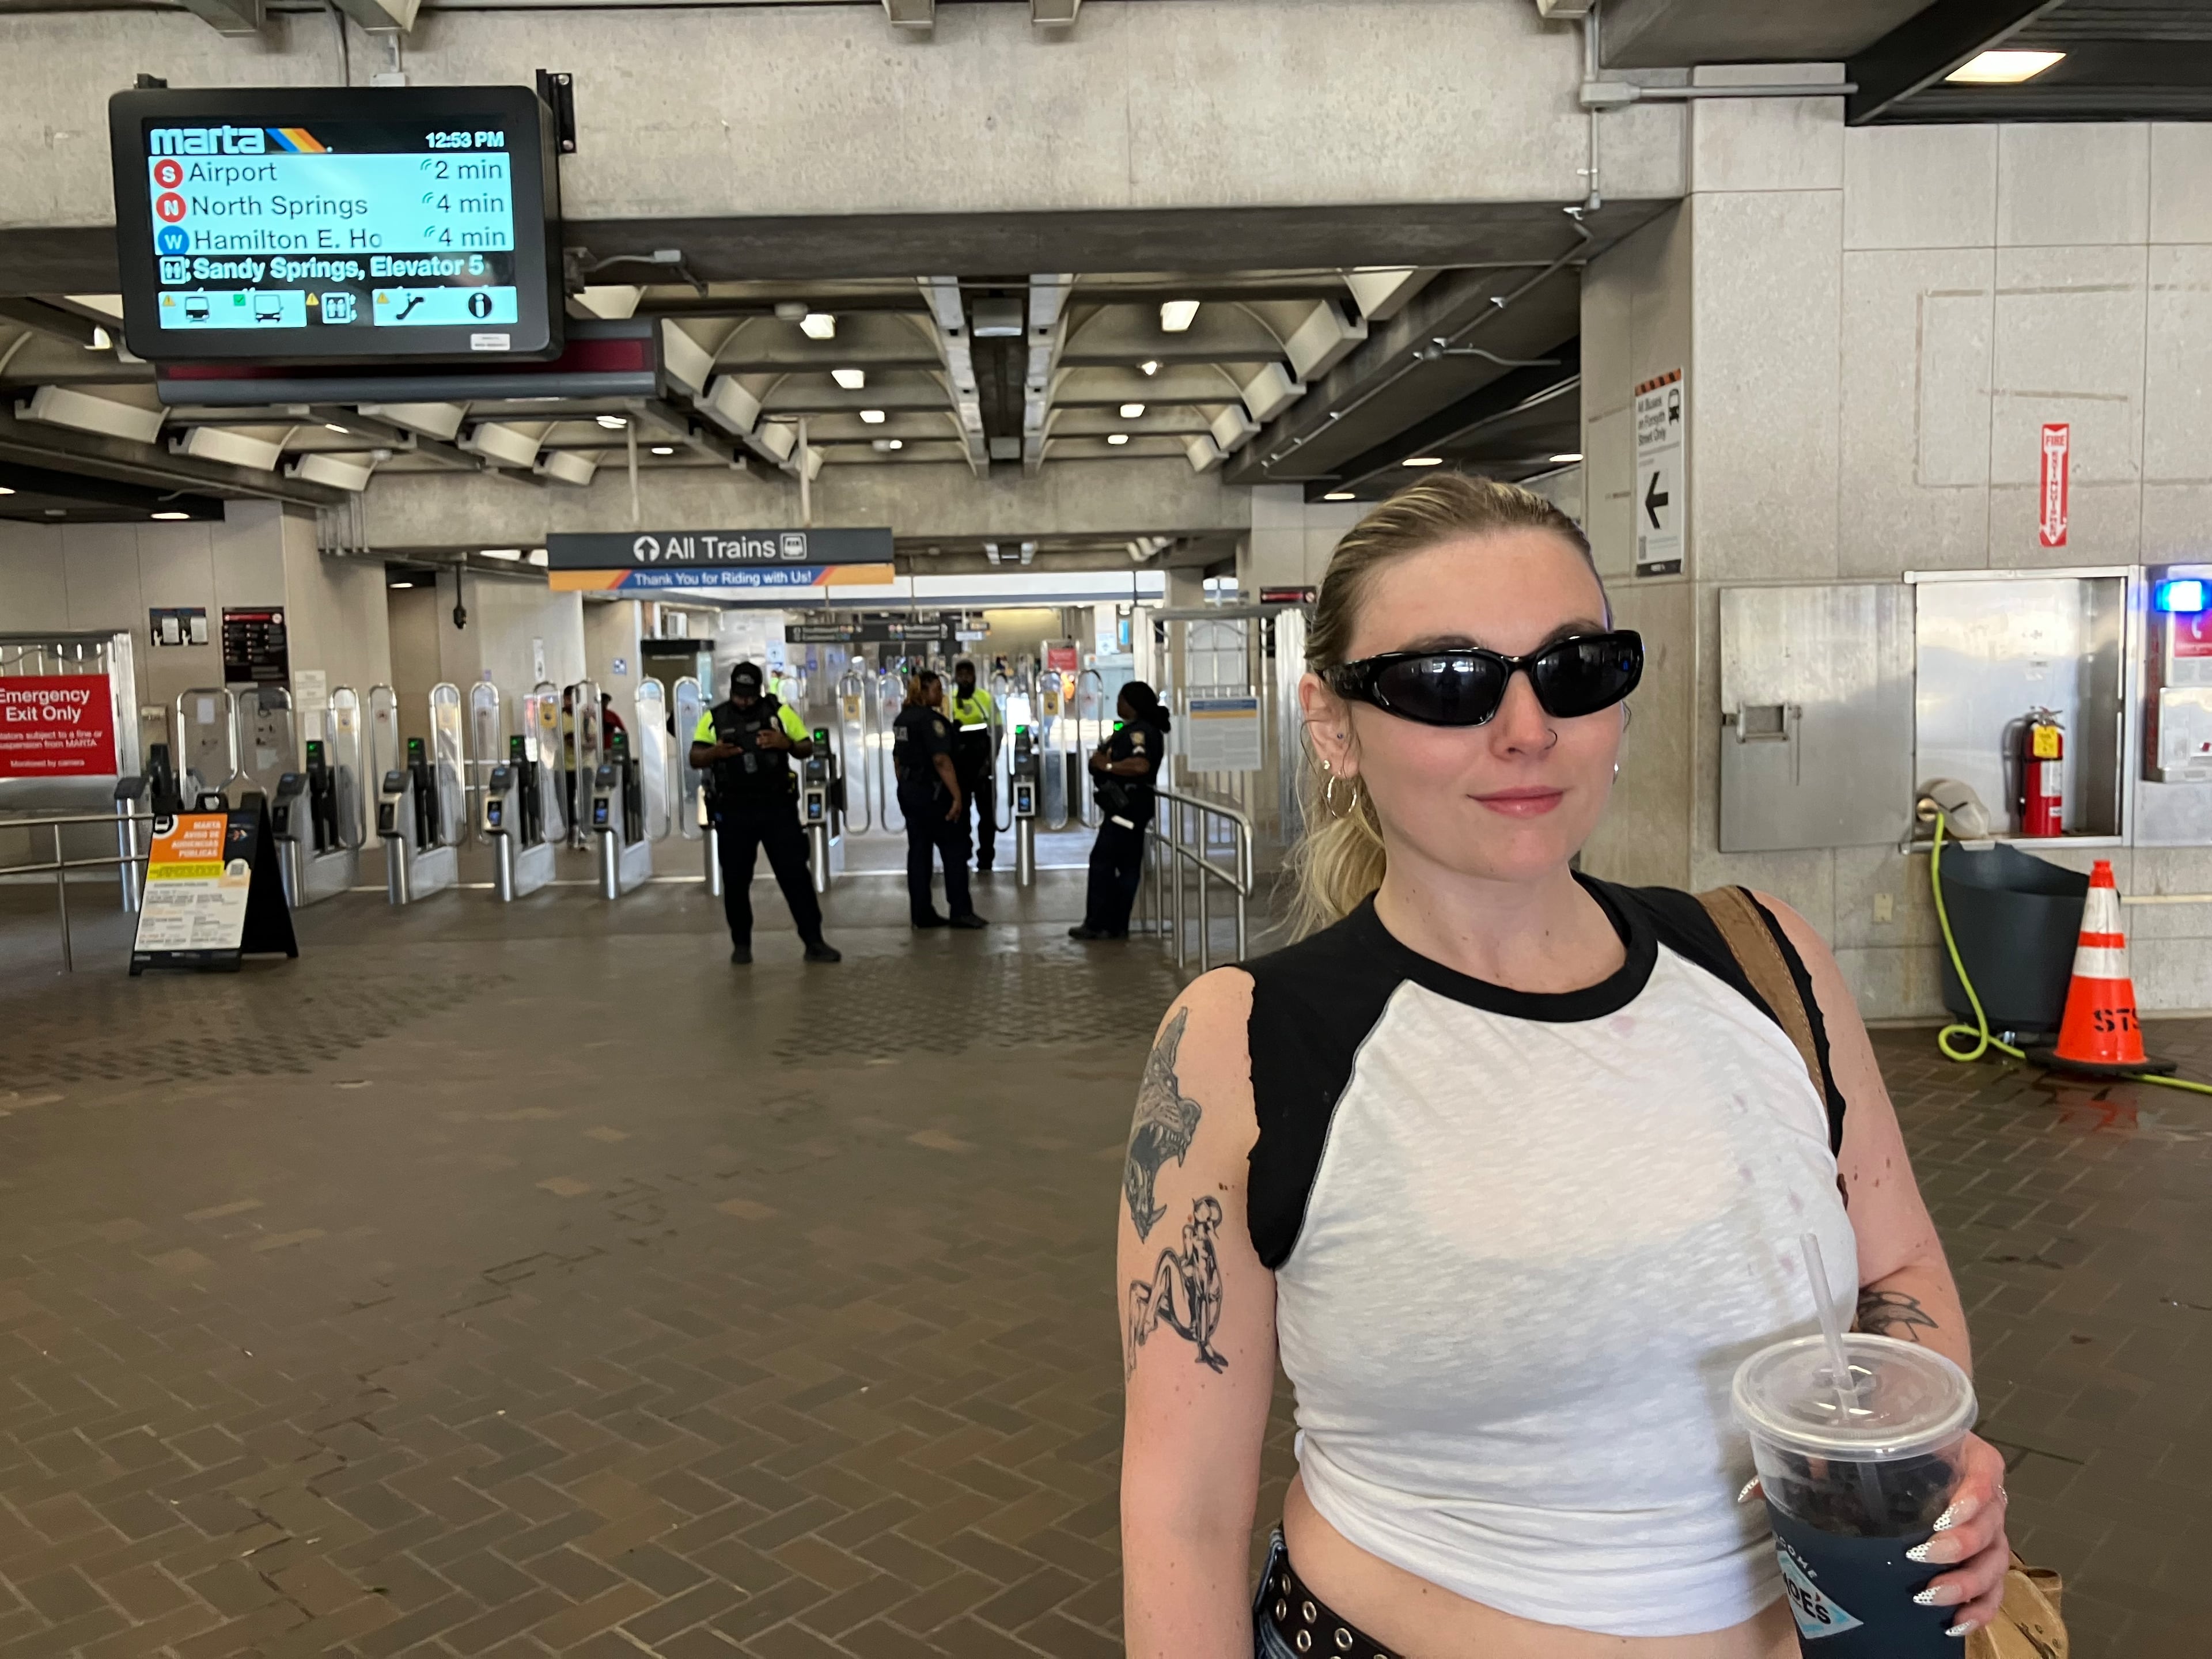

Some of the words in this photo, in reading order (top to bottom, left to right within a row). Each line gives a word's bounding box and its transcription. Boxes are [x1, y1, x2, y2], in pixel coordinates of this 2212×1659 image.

[150, 125, 265, 154] marta
[426, 132, 472, 148] 12:53
[474, 131, 504, 147] PM
[162, 166, 176, 183] S
[188, 162, 278, 185] Airport
[435, 160, 449, 179] 2
[458, 159, 502, 179] min
[164, 200, 179, 217] N
[192, 196, 262, 215] North
[271, 195, 368, 219] Springs
[437, 194, 451, 213] 4
[460, 193, 504, 213] min
[164, 234, 183, 250] W
[195, 229, 308, 250] Hamilton
[317, 228, 340, 249] E.
[439, 227, 453, 247] 4
[461, 226, 506, 247] min
[192, 257, 266, 283] Sandy
[270, 256, 365, 283] Springs,
[370, 255, 465, 278] Elevator
[468, 254, 484, 276] 5
[2046, 435, 2065, 446] FIRE
[665, 537, 695, 560] All
[701, 536, 776, 559] Trains
[634, 573, 673, 586] Thank
[675, 573, 699, 586] You
[702, 572, 718, 585] for
[721, 570, 760, 587] Riding
[762, 570, 789, 584] with
[791, 570, 812, 583] Us!
[0, 688, 90, 706] Emergency
[6, 706, 39, 722] Exit
[43, 705, 82, 724] Only
[66, 738, 97, 748] MARTA
